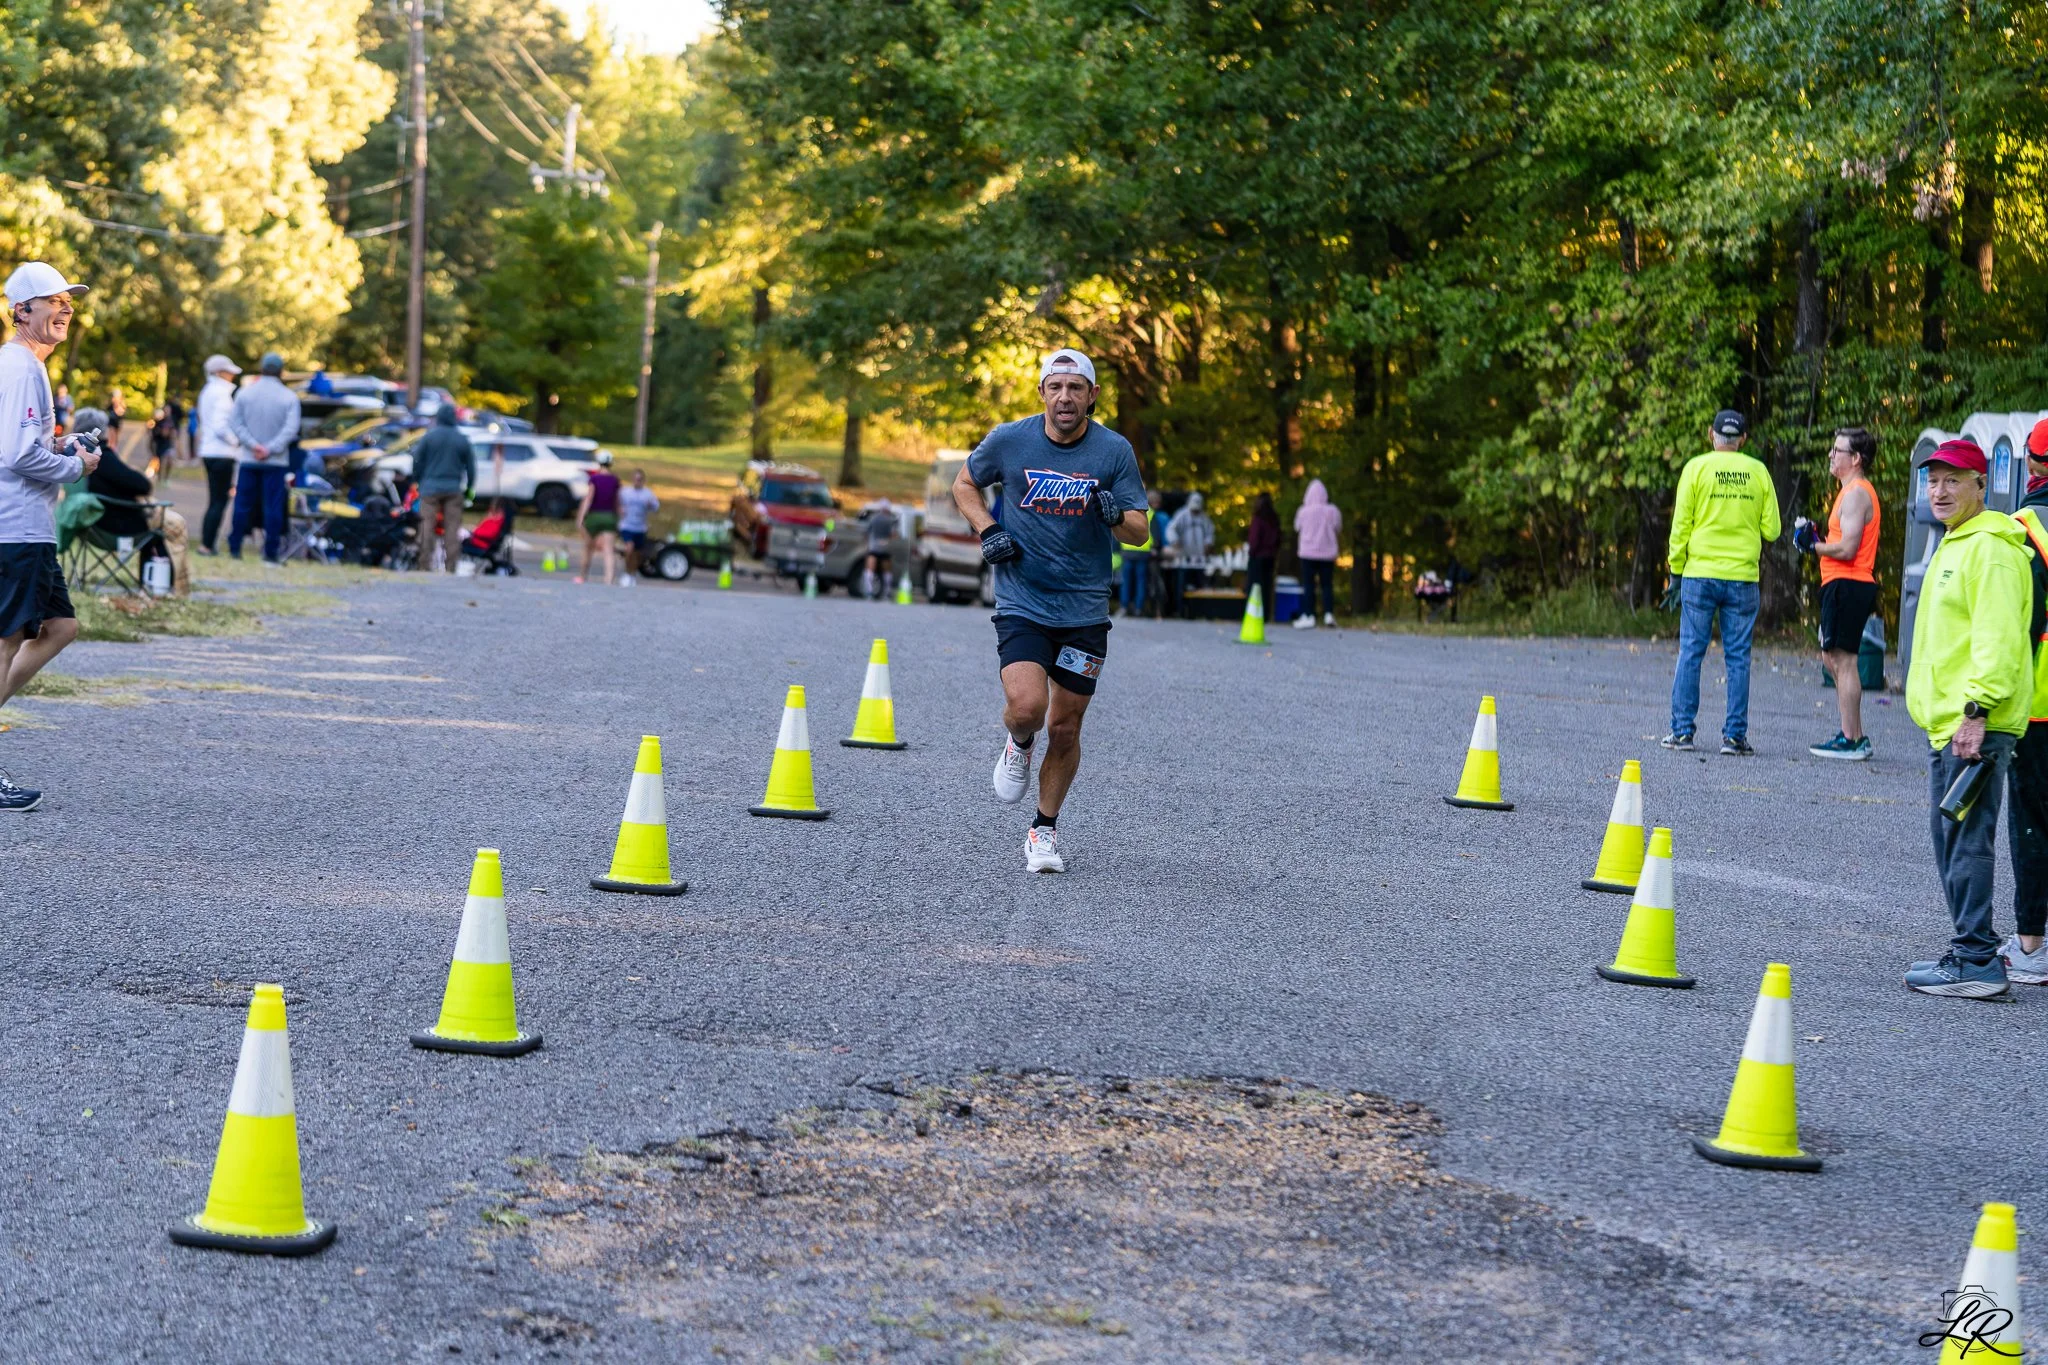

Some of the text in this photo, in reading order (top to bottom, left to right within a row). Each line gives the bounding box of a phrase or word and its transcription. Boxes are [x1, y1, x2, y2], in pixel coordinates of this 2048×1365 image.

[1715, 471, 1751, 479] MEMPHIS
[1020, 469, 1099, 509] THUNDER
[1036, 505, 1084, 516] RACING
